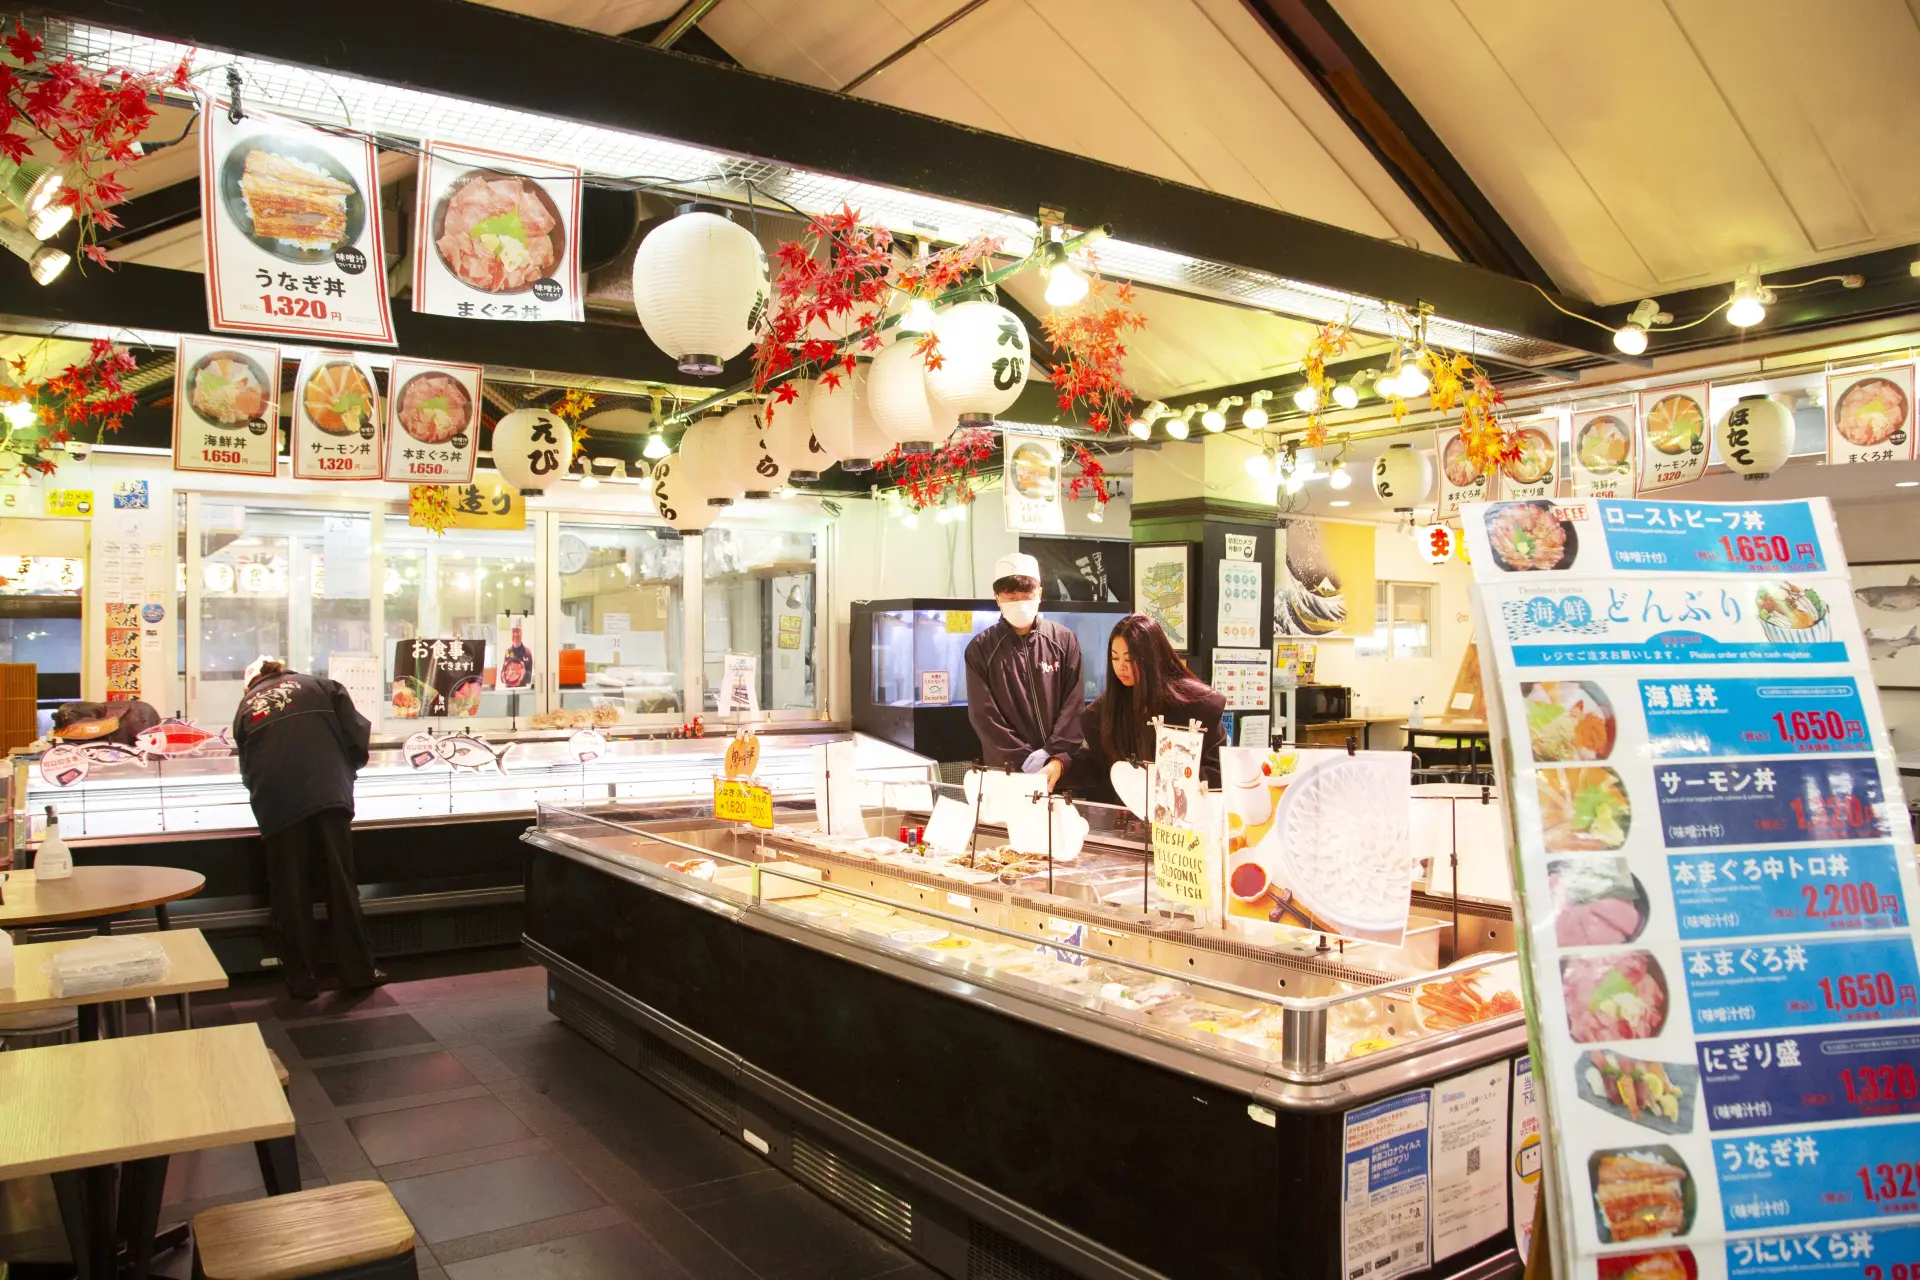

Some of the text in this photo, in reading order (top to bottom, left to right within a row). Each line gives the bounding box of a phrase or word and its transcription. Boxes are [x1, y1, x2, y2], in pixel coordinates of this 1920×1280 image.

[255, 268, 347, 297] うなぎ丼
[457, 301, 542, 320] まぐろ丼
[992, 314, 1024, 391] えび
[204, 434, 247, 449] 海鮮丼
[310, 442, 371, 455] サーモン丼
[527, 417, 560, 476] えび
[1726, 407, 1755, 466] ほたて
[402, 448, 463, 462] 本まぐろ丼
[1654, 457, 1698, 472] サーモン丼
[1376, 457, 1394, 498] うに
[444, 483, 511, 515] 造り
[1553, 506, 1586, 521] BEEF
[1605, 507, 1766, 531] ローストビーフ丼
[1530, 599, 1588, 623] 海鮮
[1607, 586, 1742, 624] どんぶり
[411, 639, 465, 660] お食事
[1689, 651, 1716, 660] Please
[1718, 652, 1738, 660] order
[1750, 651, 1763, 659] the
[1764, 651, 1782, 659] cash
[437, 660, 474, 672] できます!
[1645, 683, 1718, 708] 海鮮丼
[1660, 767, 1777, 795] サーモン丼
[1155, 827, 1185, 848] FRESH
[1668, 824, 1725, 840] (味噌汁付)
[1153, 845, 1203, 874] DELICIOUS
[1673, 853, 1851, 886] 本まぐろ中トロ丼
[1176, 884, 1203, 900] FISH
[1687, 944, 1809, 978] 本まぐろ丼
[1703, 1039, 1802, 1073] にぎり盛
[1838, 1063, 1920, 1105] 1,320
[1371, 1139, 1422, 1163] 新型コロナウイルス
[1722, 1136, 1820, 1172] うなぎ丼
[1856, 1160, 1920, 1203] 1,32
[1733, 1230, 1875, 1267] うにいくら丼
